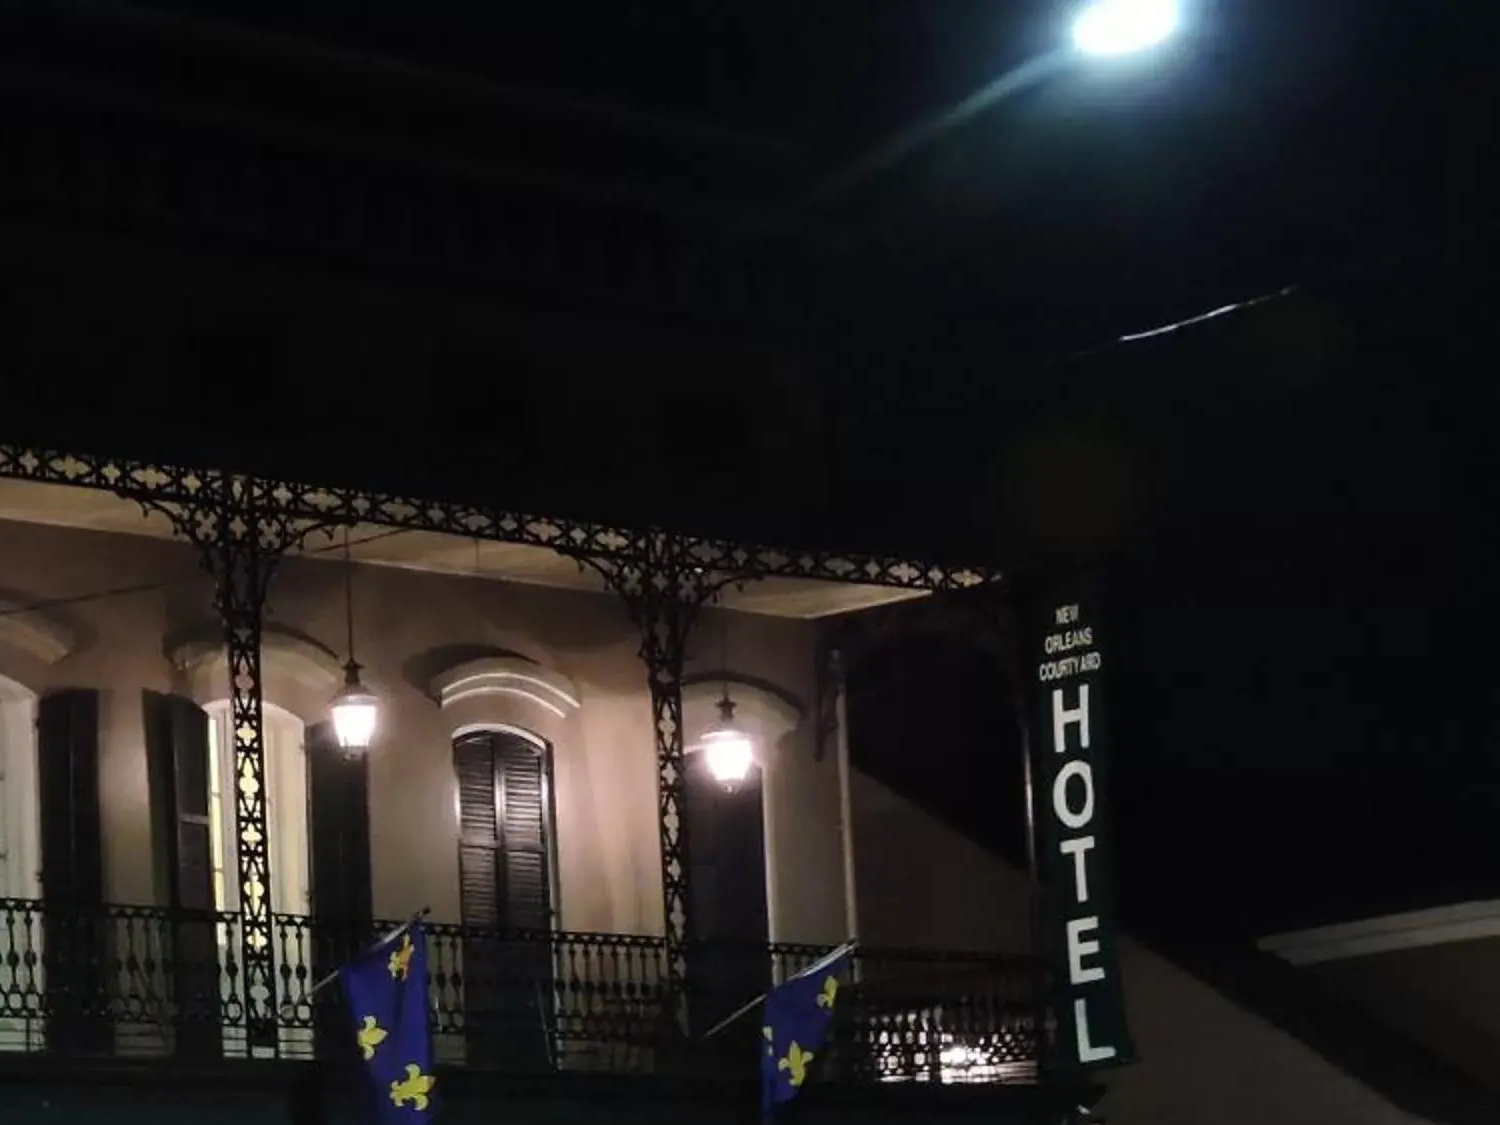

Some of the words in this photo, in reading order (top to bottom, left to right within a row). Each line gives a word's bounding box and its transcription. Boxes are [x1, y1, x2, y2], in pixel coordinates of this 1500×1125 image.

[1055, 604, 1079, 625] NEW
[1045, 626, 1093, 654] ORLEANS
[1040, 651, 1101, 681] COURTYARD
[1052, 684, 1117, 1063] HOTEL
